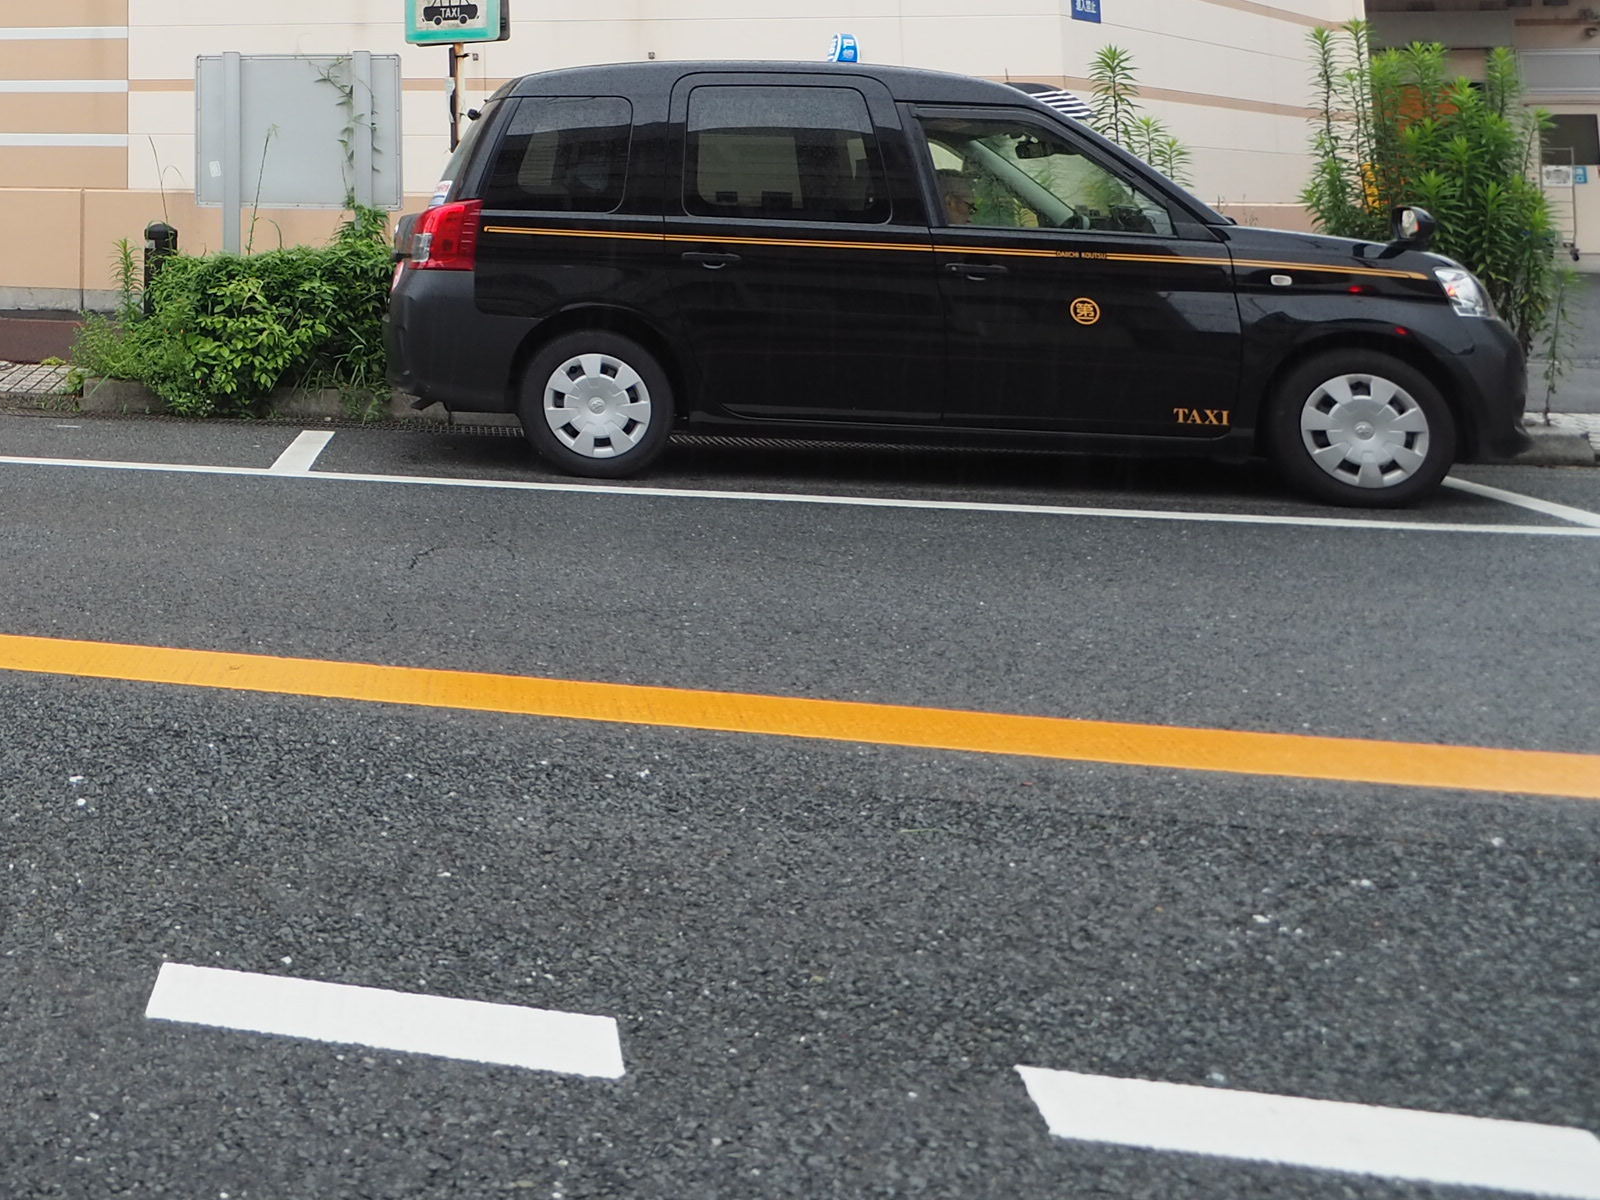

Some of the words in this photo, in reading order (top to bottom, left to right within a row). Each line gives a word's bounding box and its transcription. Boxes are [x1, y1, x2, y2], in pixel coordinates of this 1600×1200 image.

[440, 7, 461, 18] TAXI
[1081, 251, 1106, 260] KOUTSU
[1173, 407, 1231, 426] TAXI
